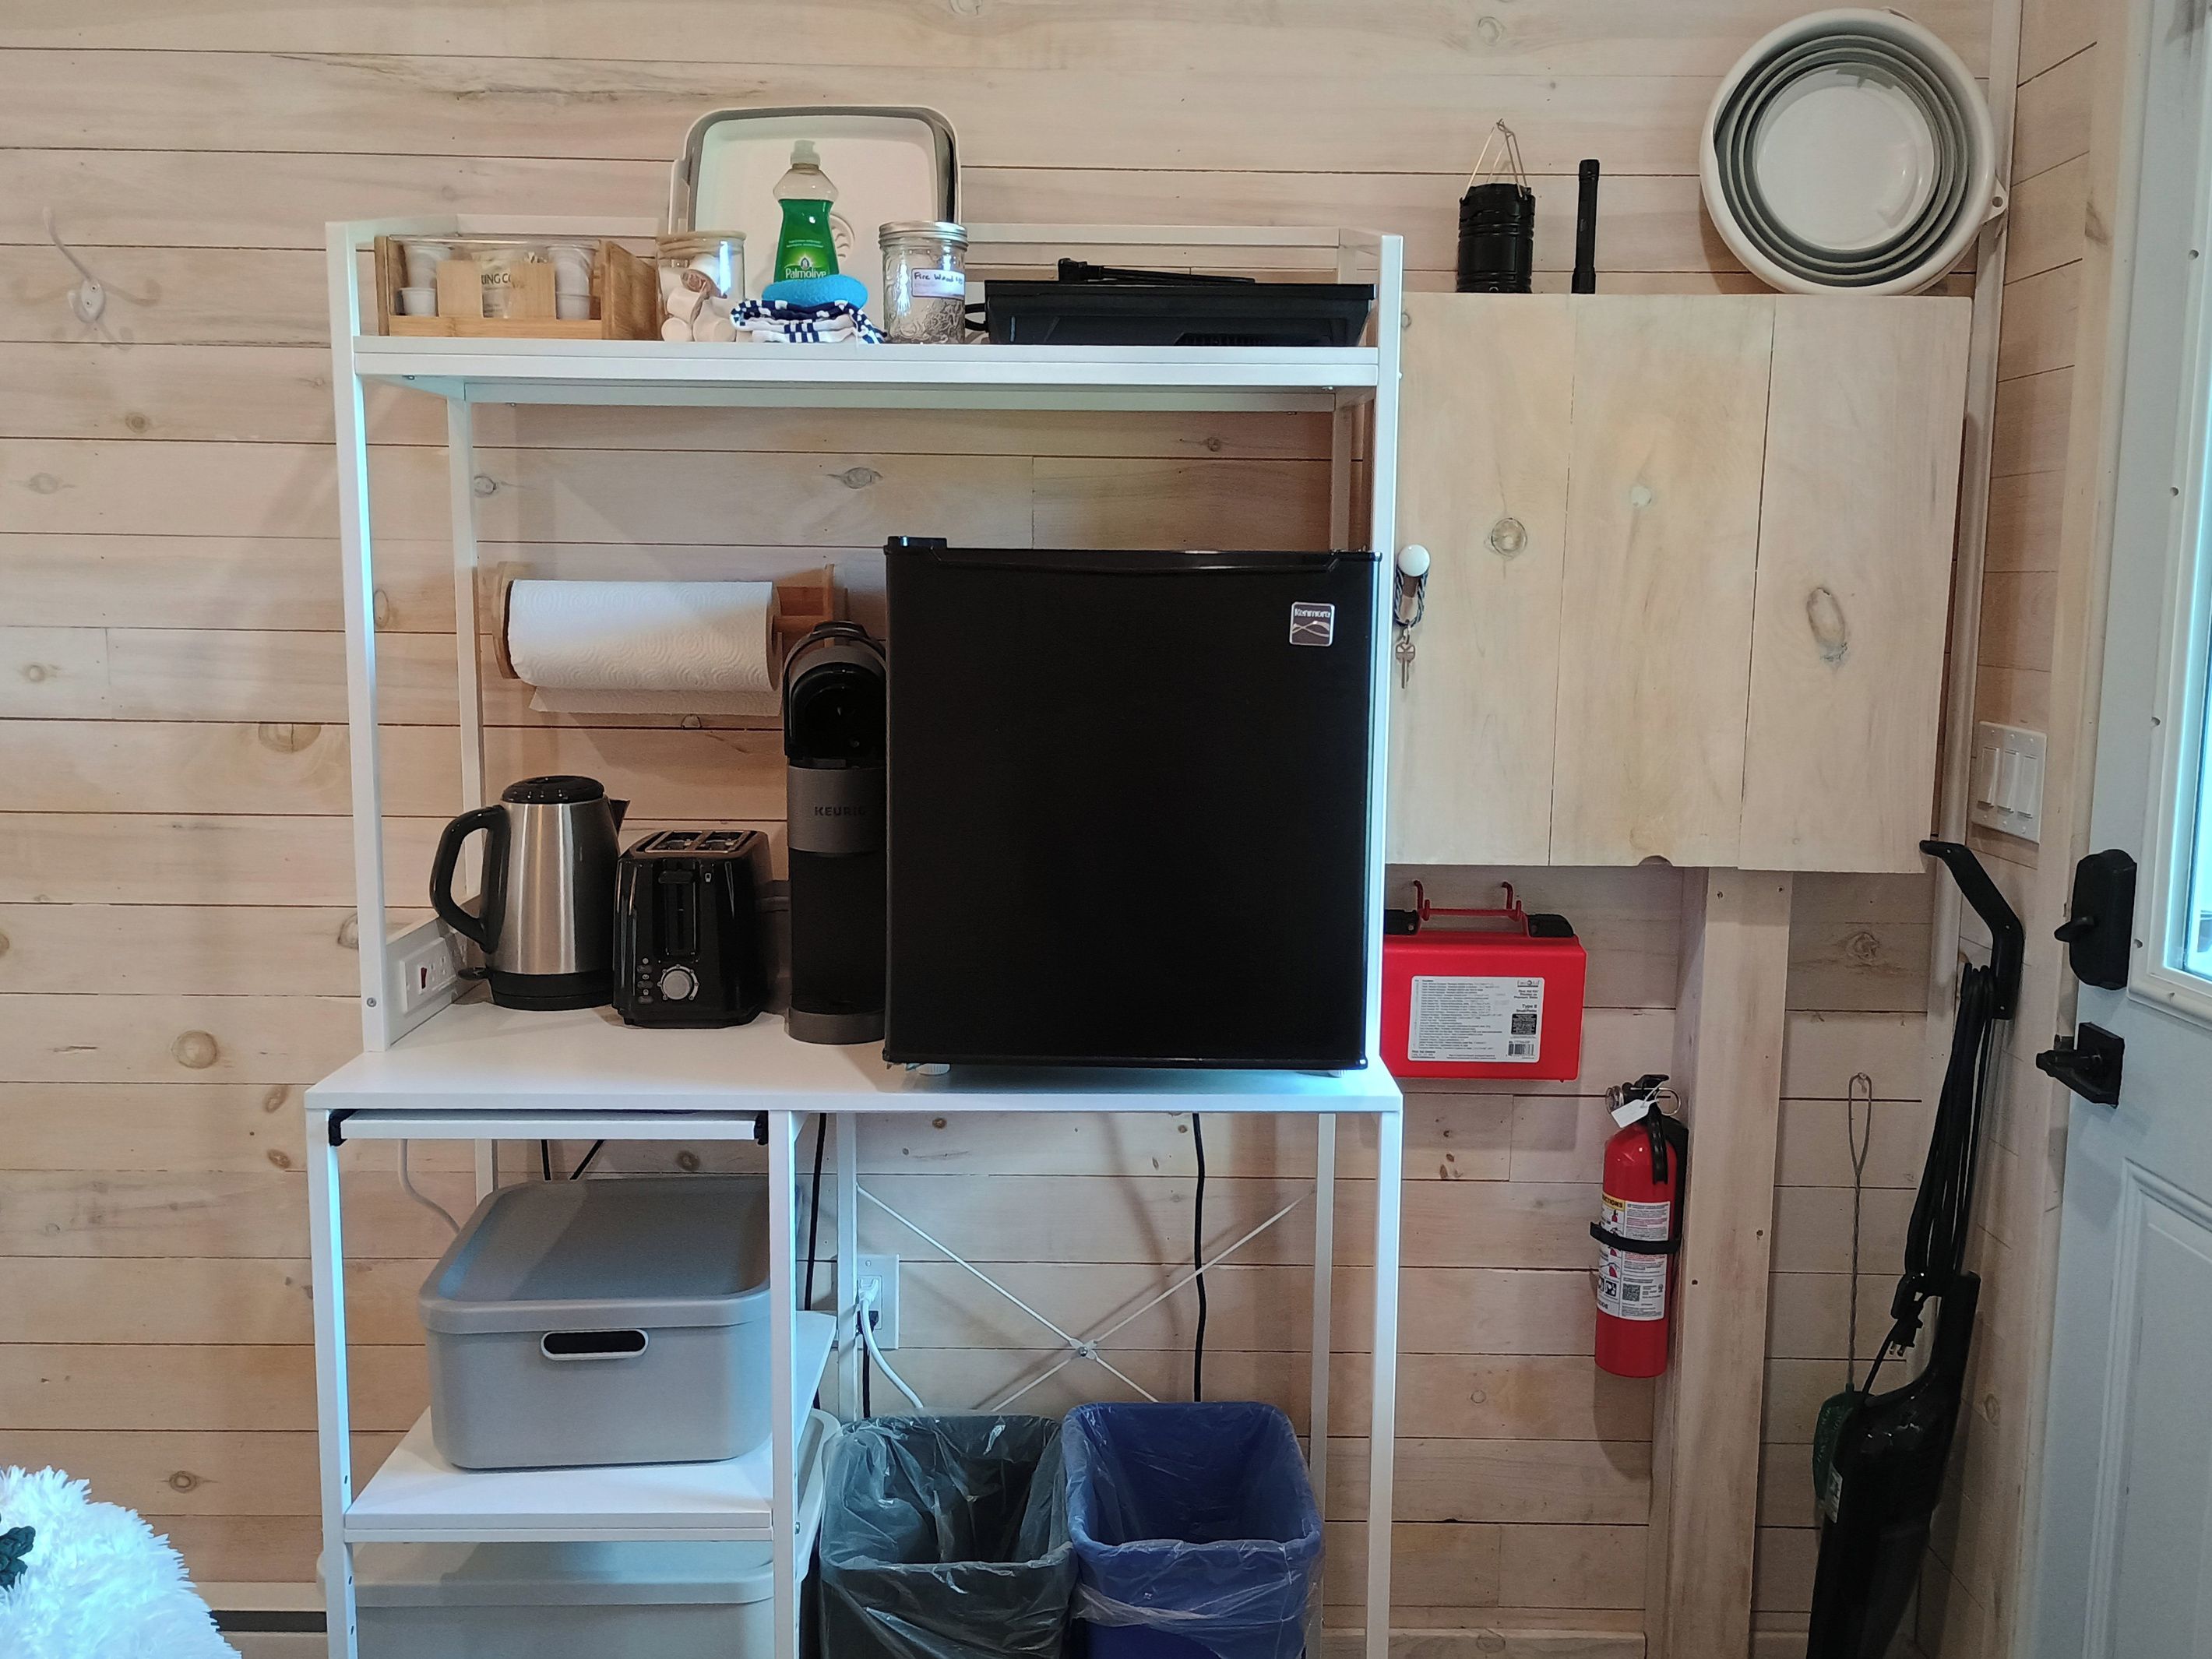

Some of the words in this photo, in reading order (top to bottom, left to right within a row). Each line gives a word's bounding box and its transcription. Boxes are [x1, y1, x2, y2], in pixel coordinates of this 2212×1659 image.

[502, 273, 511, 284] C
[785, 268, 826, 279] Palmolive
[914, 271, 930, 280] Fire
[1294, 608, 1330, 618] Kenmore
